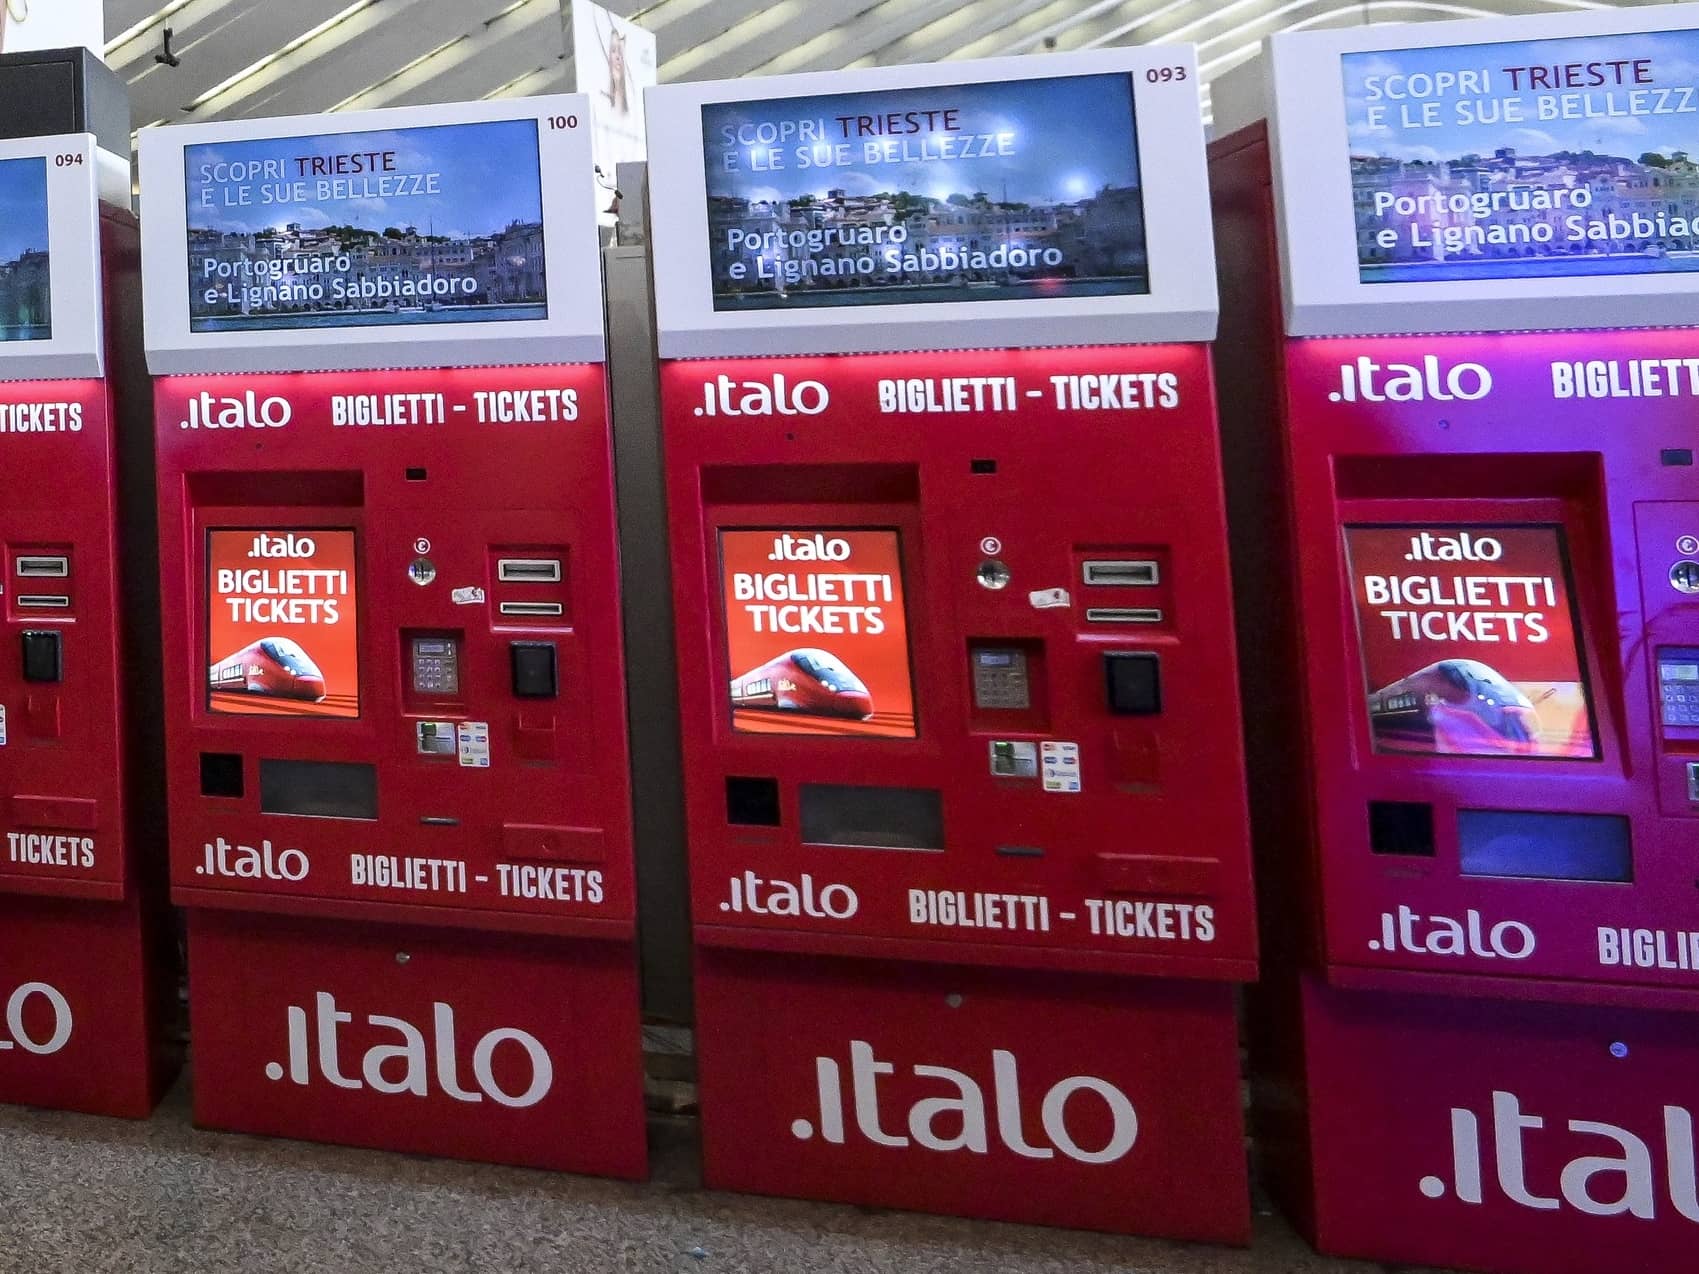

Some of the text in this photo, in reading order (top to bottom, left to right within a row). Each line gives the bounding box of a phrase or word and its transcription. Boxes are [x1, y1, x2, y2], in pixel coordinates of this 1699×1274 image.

[1145, 66, 1187, 84] 093
[1365, 60, 1654, 100] SCOPRI TRIESTE
[546, 115, 578, 131] 100
[1367, 87, 1698, 131] E LE SUE BELLEZZ
[719, 109, 961, 148] SCOPRI TRIESTE
[55, 153, 83, 167] 094
[200, 151, 396, 185] SCOPRI TRIESTE
[724, 132, 1017, 173] E LE SUE BELLEZZE
[201, 172, 441, 207] E LE SUE BELLEZZE
[1375, 184, 1592, 217] Portogruaro
[727, 221, 909, 252] Portogruaro
[1376, 228, 1399, 249] e
[1410, 219, 1553, 252] Lignano
[203, 252, 352, 281] Portogruaro
[728, 245, 1063, 283] e Lignano Sabbiadoro
[203, 272, 478, 308] e Lignano Sabbiadoro
[878, 376, 1017, 413] BIGLIETTI
[1049, 372, 1178, 410] TICKETS
[1551, 358, 1699, 399] BIGLIETT
[0, 402, 83, 433] TICKETS
[331, 393, 445, 426] BIGLIETTI
[473, 388, 578, 423] TICKETS
[218, 569, 347, 595] BIGLIETTI
[733, 573, 893, 602] BIGLIETTI
[1364, 575, 1556, 607] BIGLIETTI
[225, 597, 339, 625] TICKETS
[744, 604, 885, 635] TICKETS
[1380, 611, 1549, 643] TICKETS
[6, 832, 95, 868] TICKETS
[350, 853, 467, 893] BIGLIETTI
[495, 863, 604, 904] TICKETS
[908, 888, 1050, 932] BIGLIETTI
[1084, 898, 1215, 942] TICKETS
